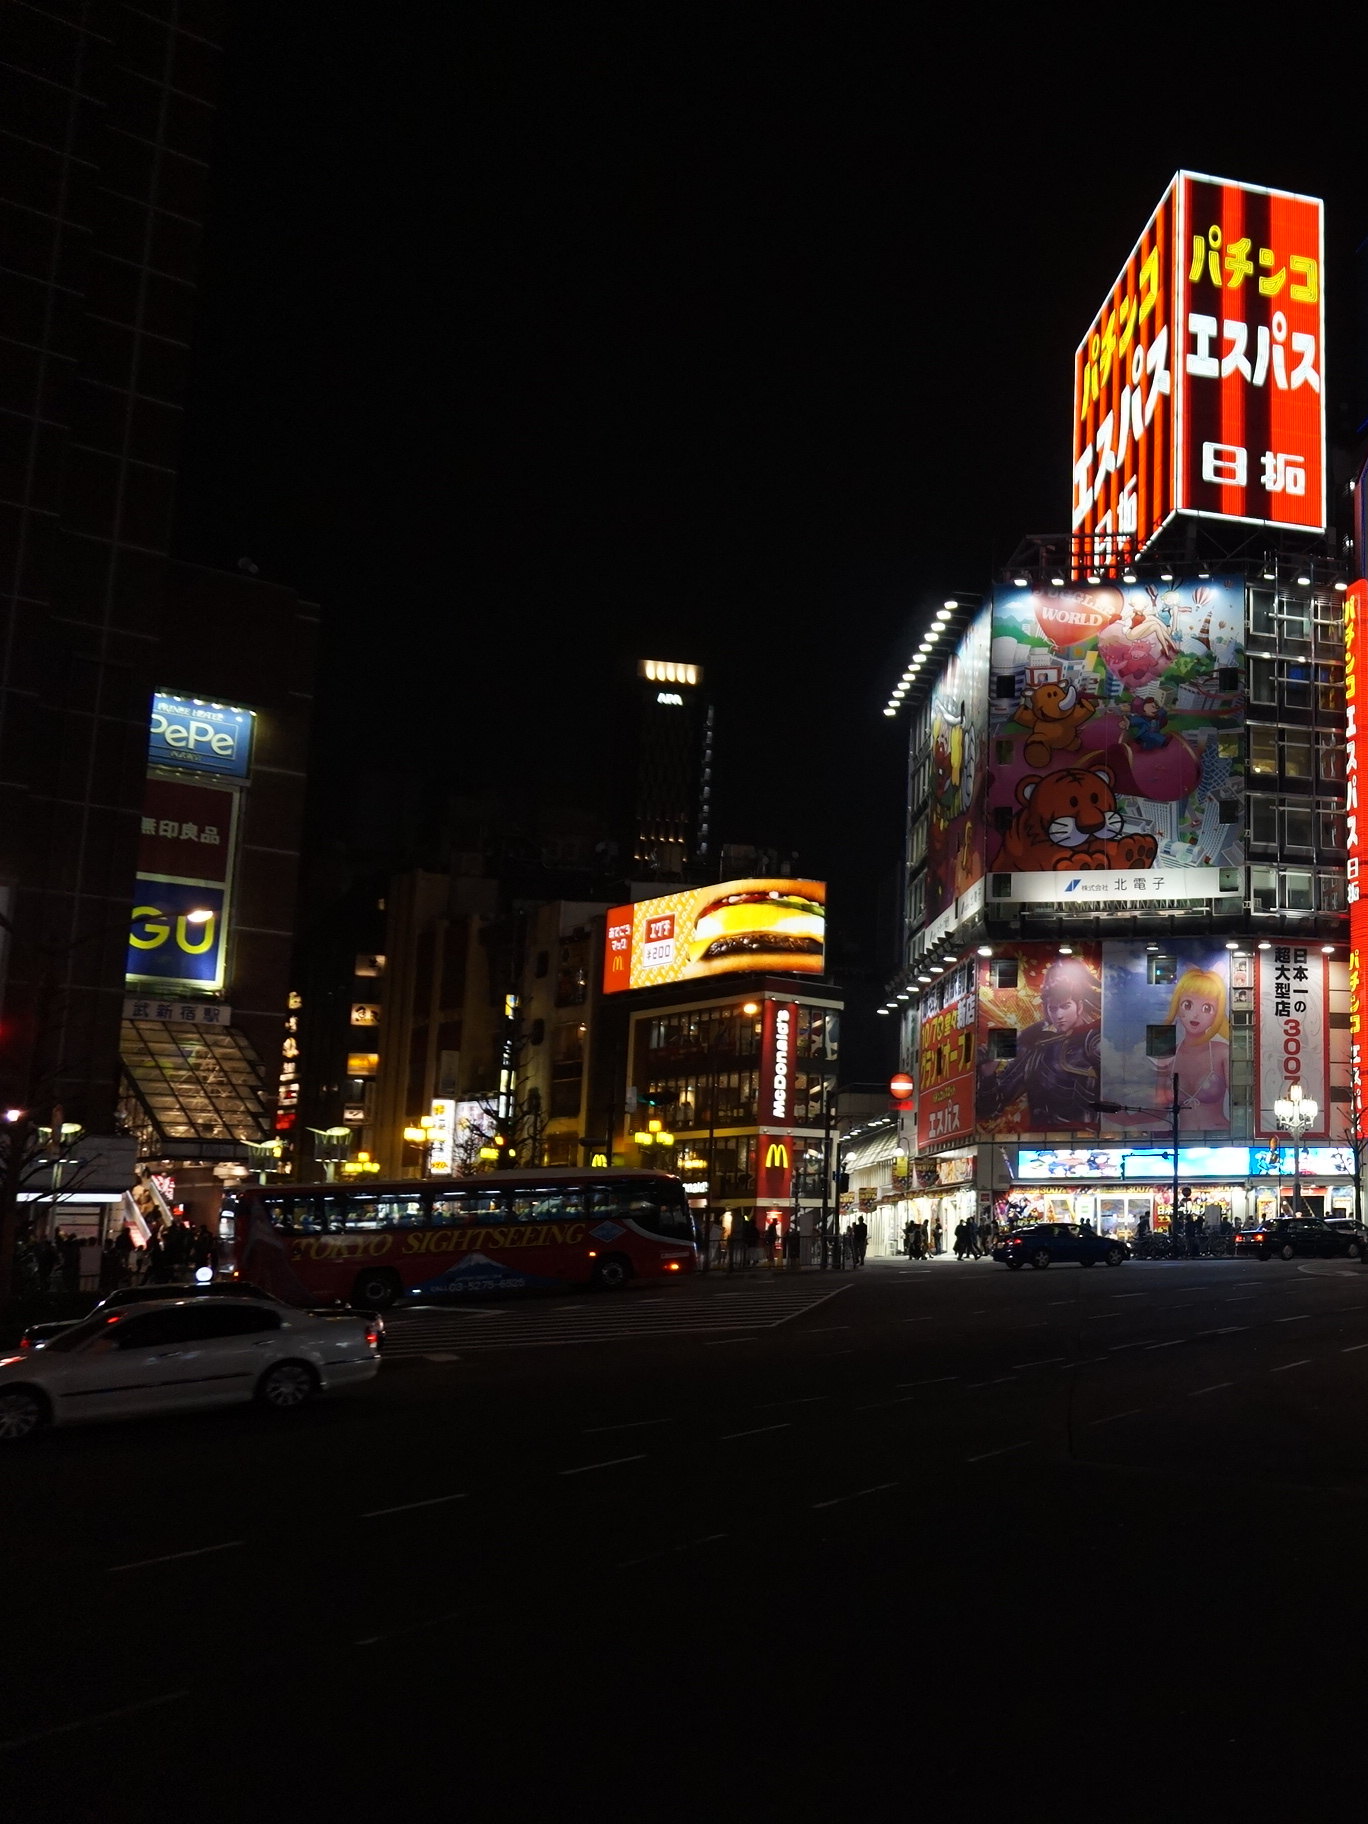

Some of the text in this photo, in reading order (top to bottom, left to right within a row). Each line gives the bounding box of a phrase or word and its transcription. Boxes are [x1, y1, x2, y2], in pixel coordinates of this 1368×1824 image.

[1190, 225, 1318, 303] パチンコ
[1081, 245, 1159, 421] パチンコ
[1186, 311, 1320, 394] エスパス
[1074, 325, 1170, 528] エスパス
[1202, 441, 1306, 496] 日拓
[1042, 606, 1103, 627] WORLD
[1344, 595, 1357, 699] パチンコ
[1345, 704, 1358, 850] エスパス
[1114, 877, 1165, 891] 北電子
[129, 905, 217, 955] GU
[1275, 947, 1291, 1018] 超大型店
[1293, 948, 1308, 1013] 日本一の
[1349, 949, 1360, 1033] パチンコ
[772, 1009, 790, 1119] McDonald's
[928, 1099, 960, 1138] エスパス
[291, 1223, 587, 1262] TOKYO SIGHTSEEING
